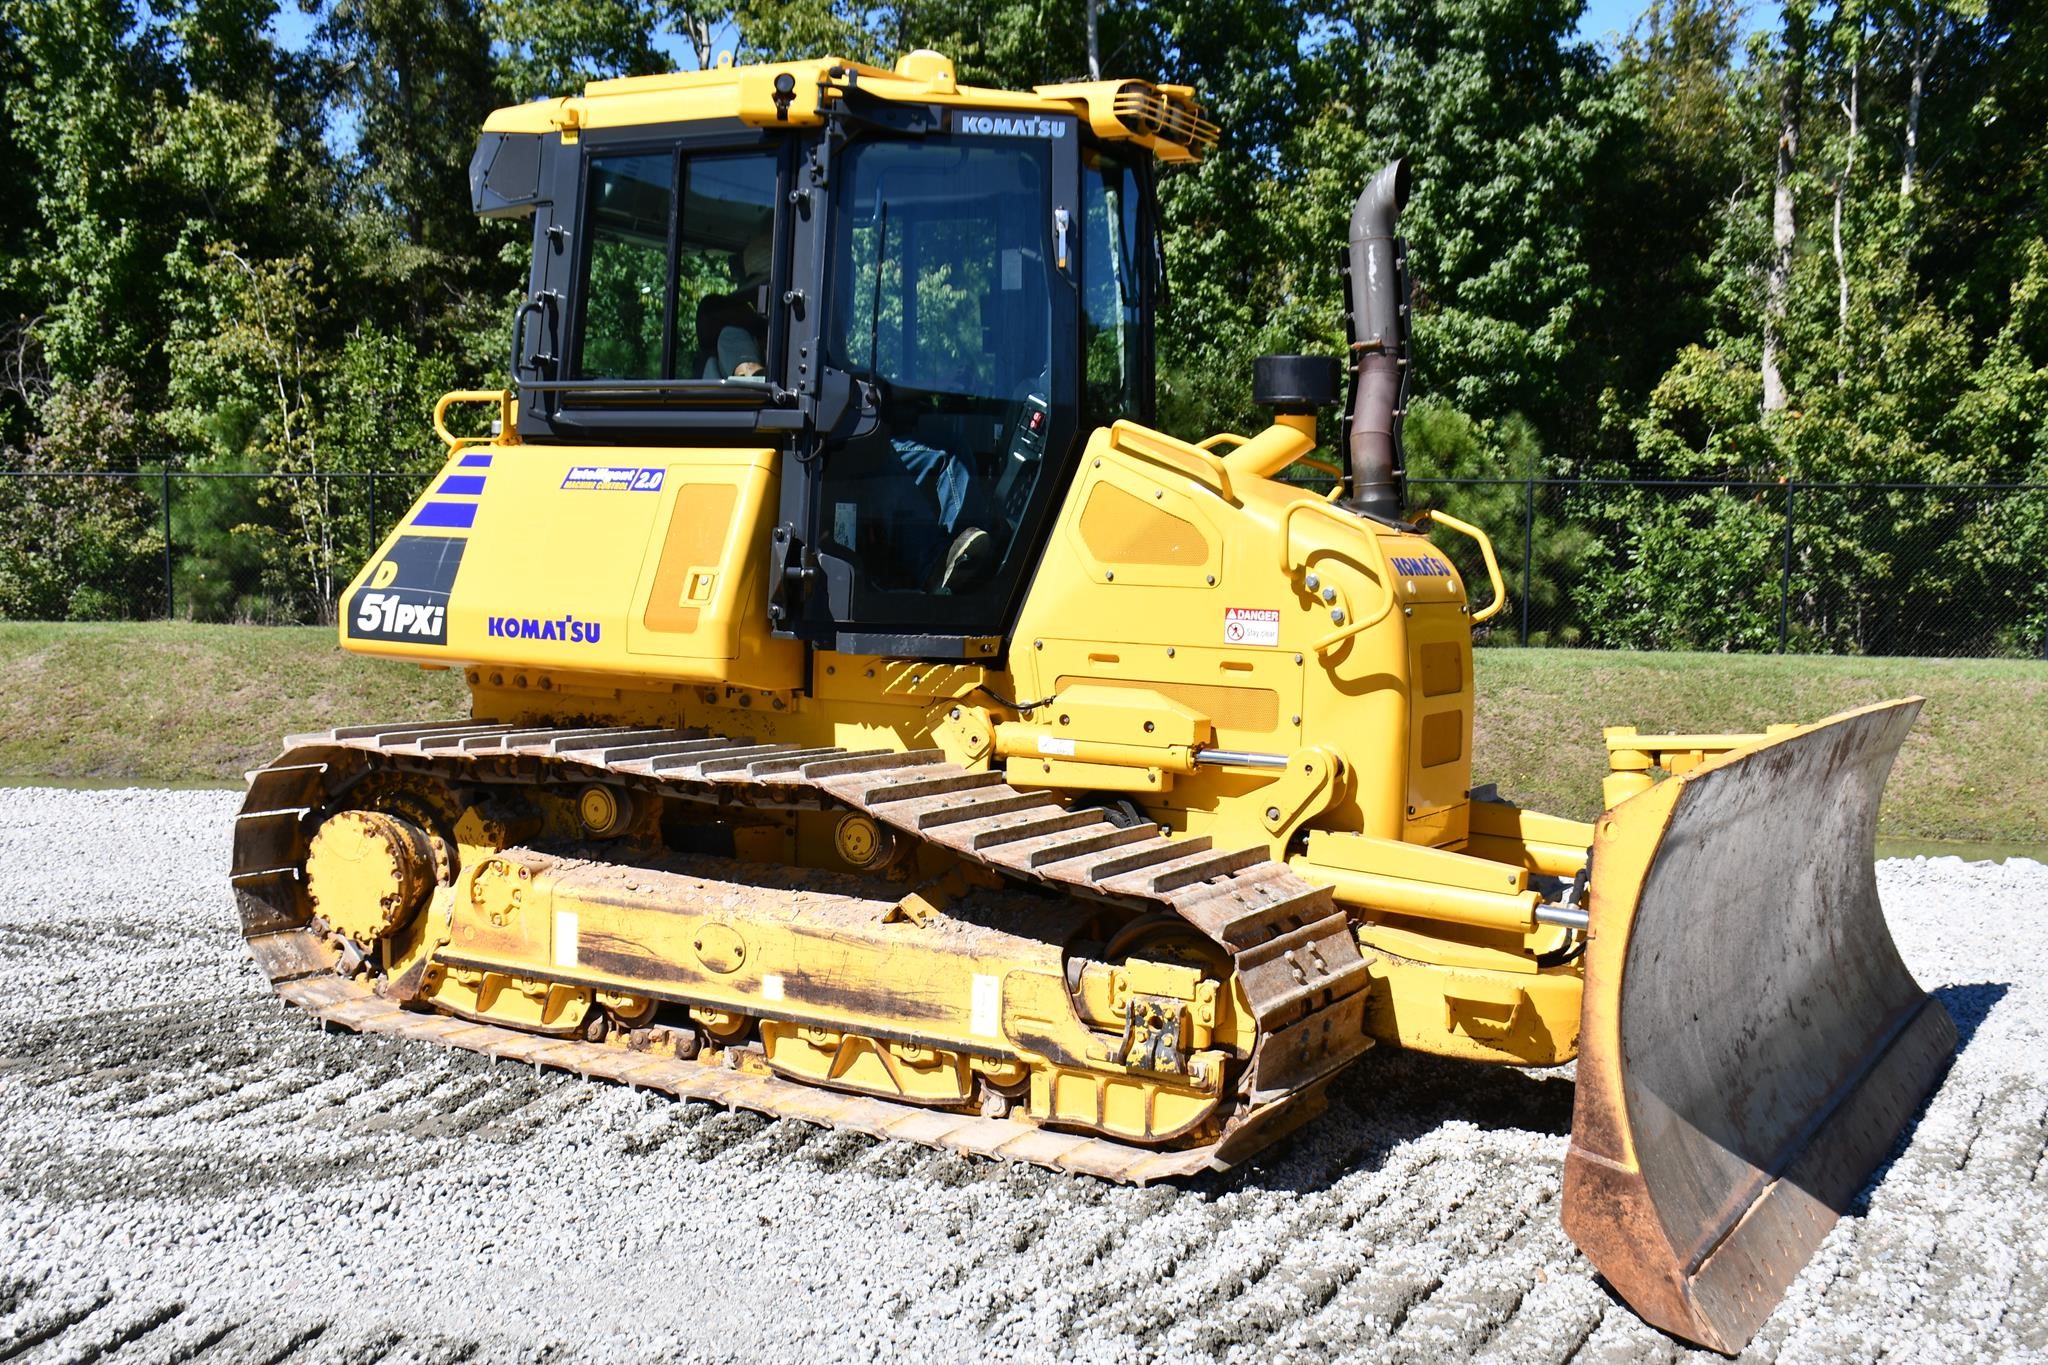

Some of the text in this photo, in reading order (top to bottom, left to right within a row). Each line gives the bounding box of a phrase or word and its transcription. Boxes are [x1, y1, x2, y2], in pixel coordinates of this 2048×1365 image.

[962, 115, 1066, 138] KOMATSU
[633, 471, 664, 489] 2.0
[369, 561, 399, 589] D
[1390, 553, 1451, 576] KOMATSU
[357, 593, 445, 636] 51PXi
[1237, 609, 1280, 622] DANGER
[488, 615, 600, 643] KOMATSU
[1246, 628, 1260, 638] Stay
